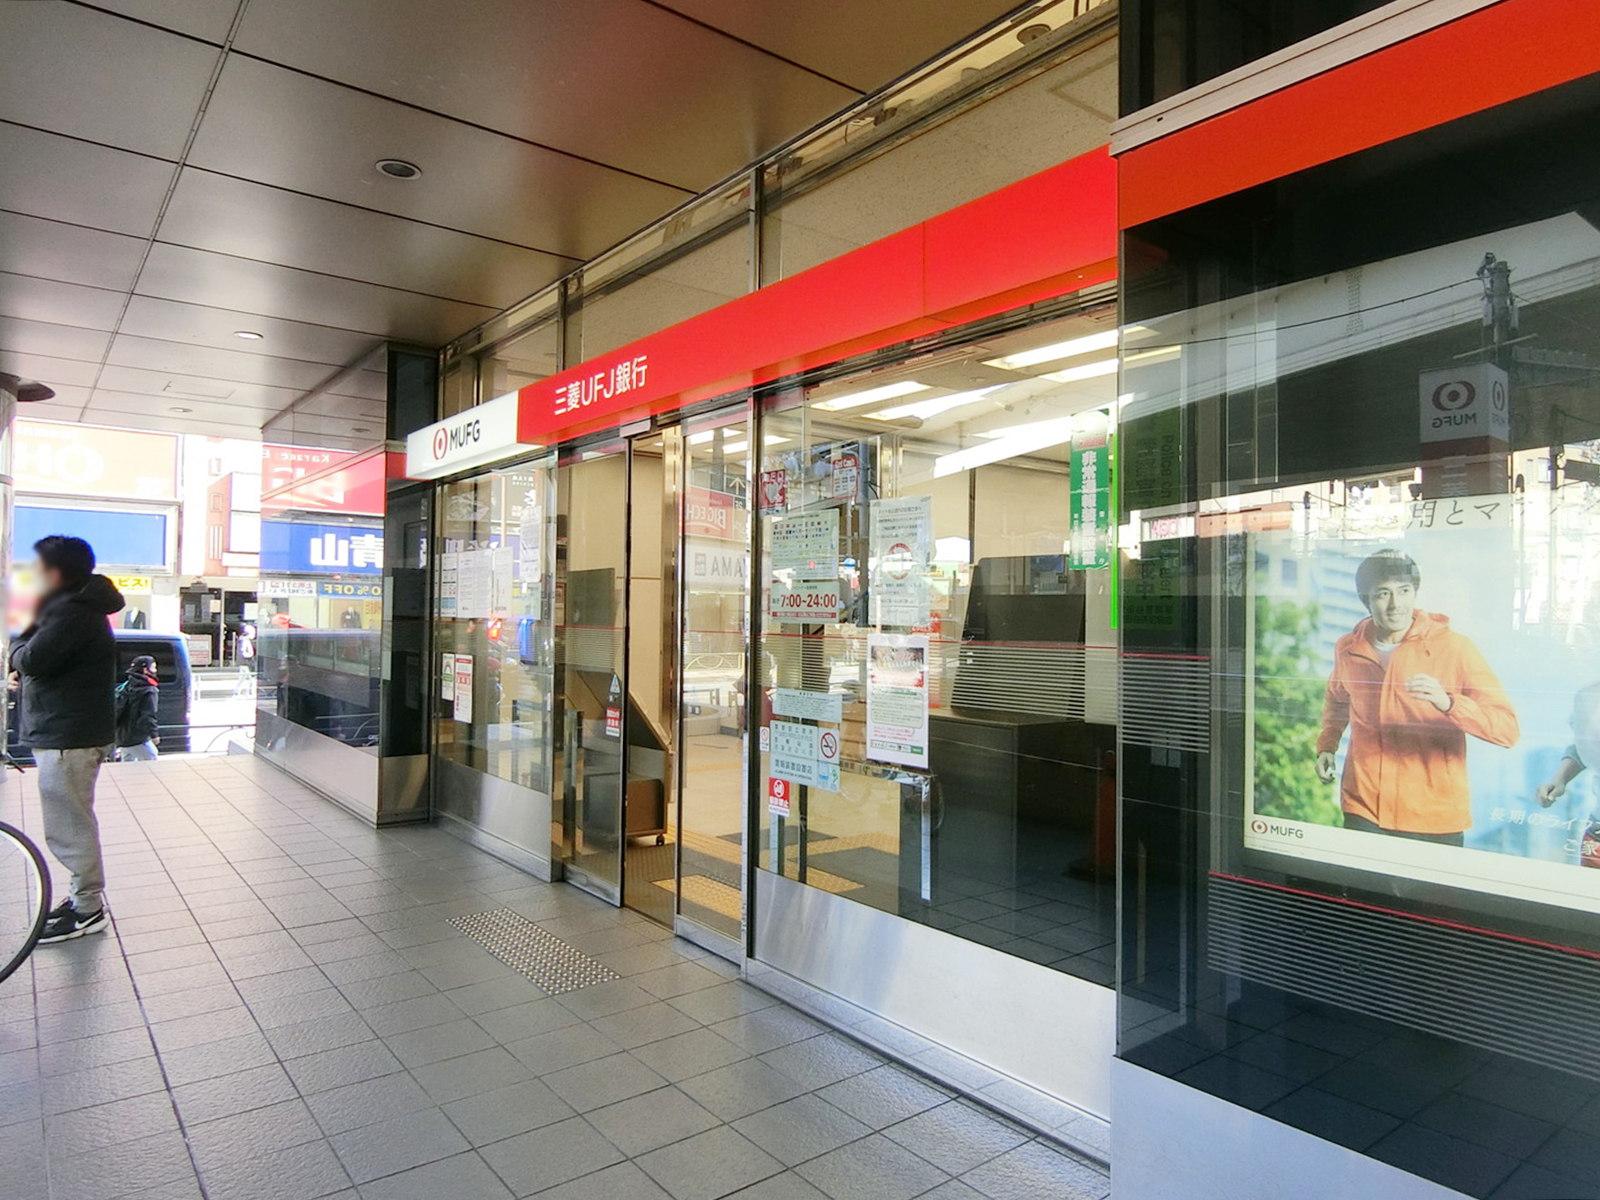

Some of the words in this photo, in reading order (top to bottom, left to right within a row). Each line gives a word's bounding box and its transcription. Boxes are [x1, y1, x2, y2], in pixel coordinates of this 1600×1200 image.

[553, 355, 648, 416] 三菱UFJ銀行
[449, 418, 481, 452] MUFG
[1270, 825, 1304, 839] MUFG
